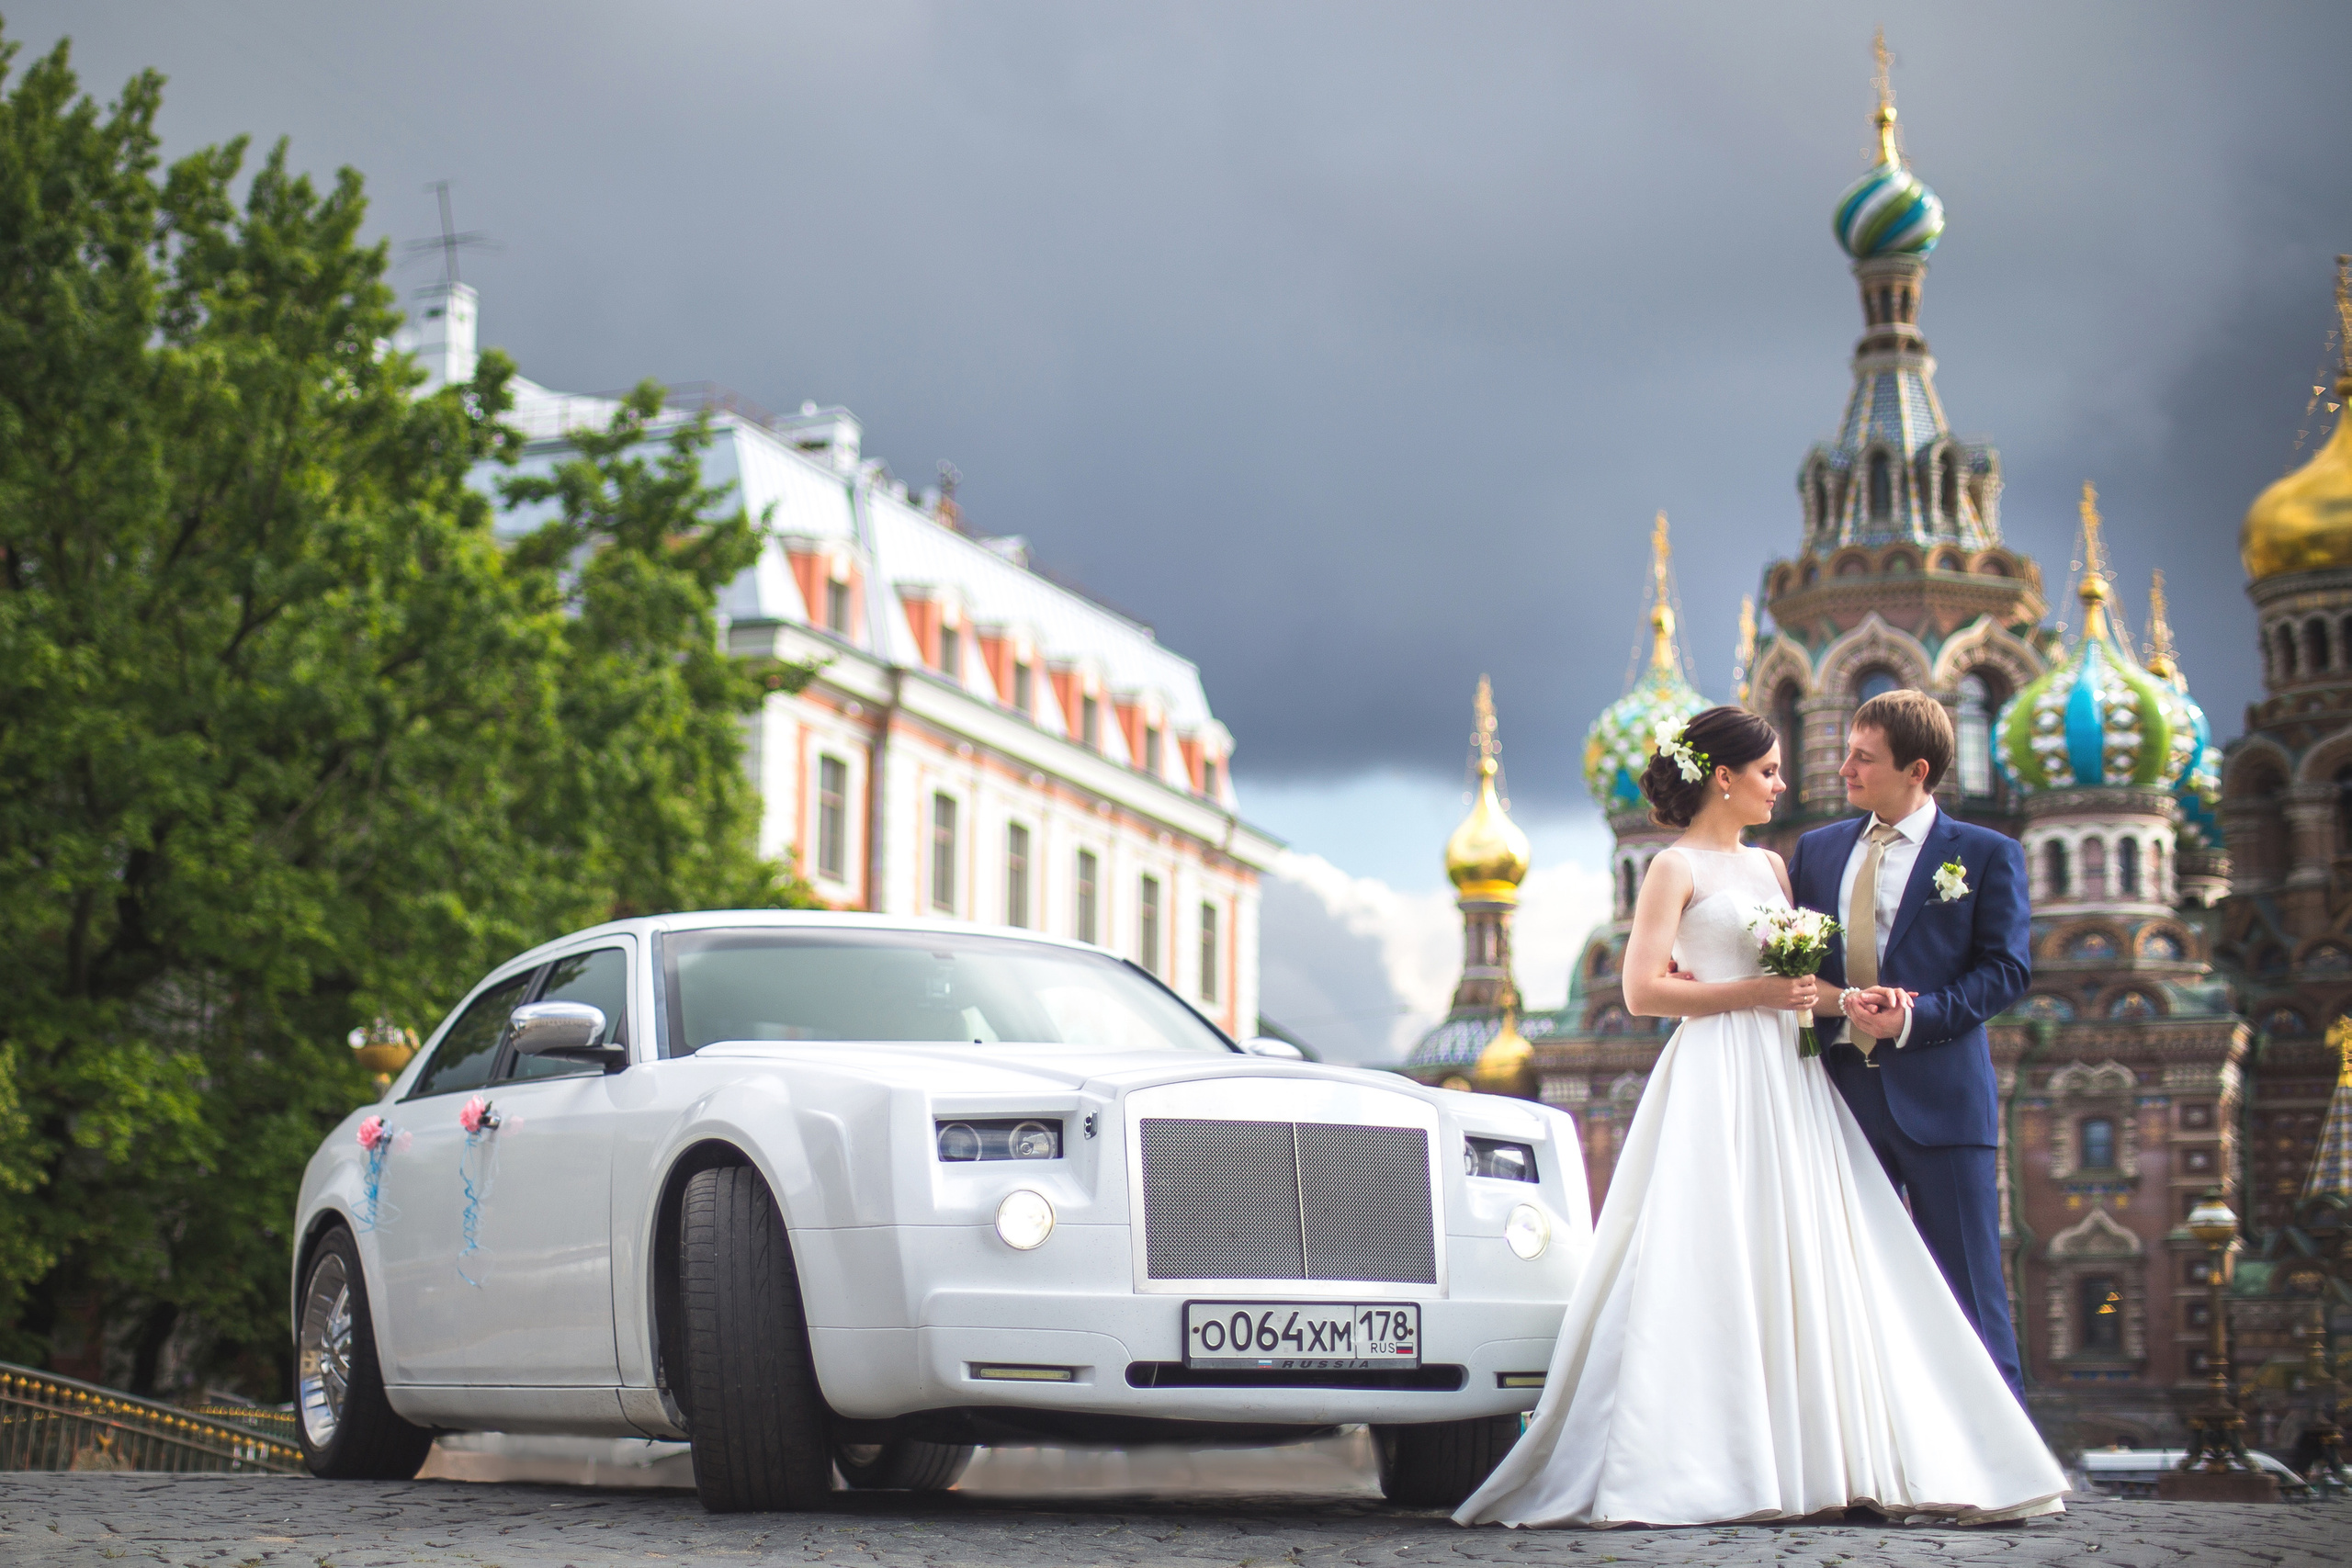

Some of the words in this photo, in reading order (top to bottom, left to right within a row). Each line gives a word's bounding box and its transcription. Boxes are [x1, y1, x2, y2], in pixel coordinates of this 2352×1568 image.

[1359, 1311, 1408, 1341] 178
[1371, 1342, 1396, 1354] RUS
[1282, 1359, 1370, 1369] RUSSIA
